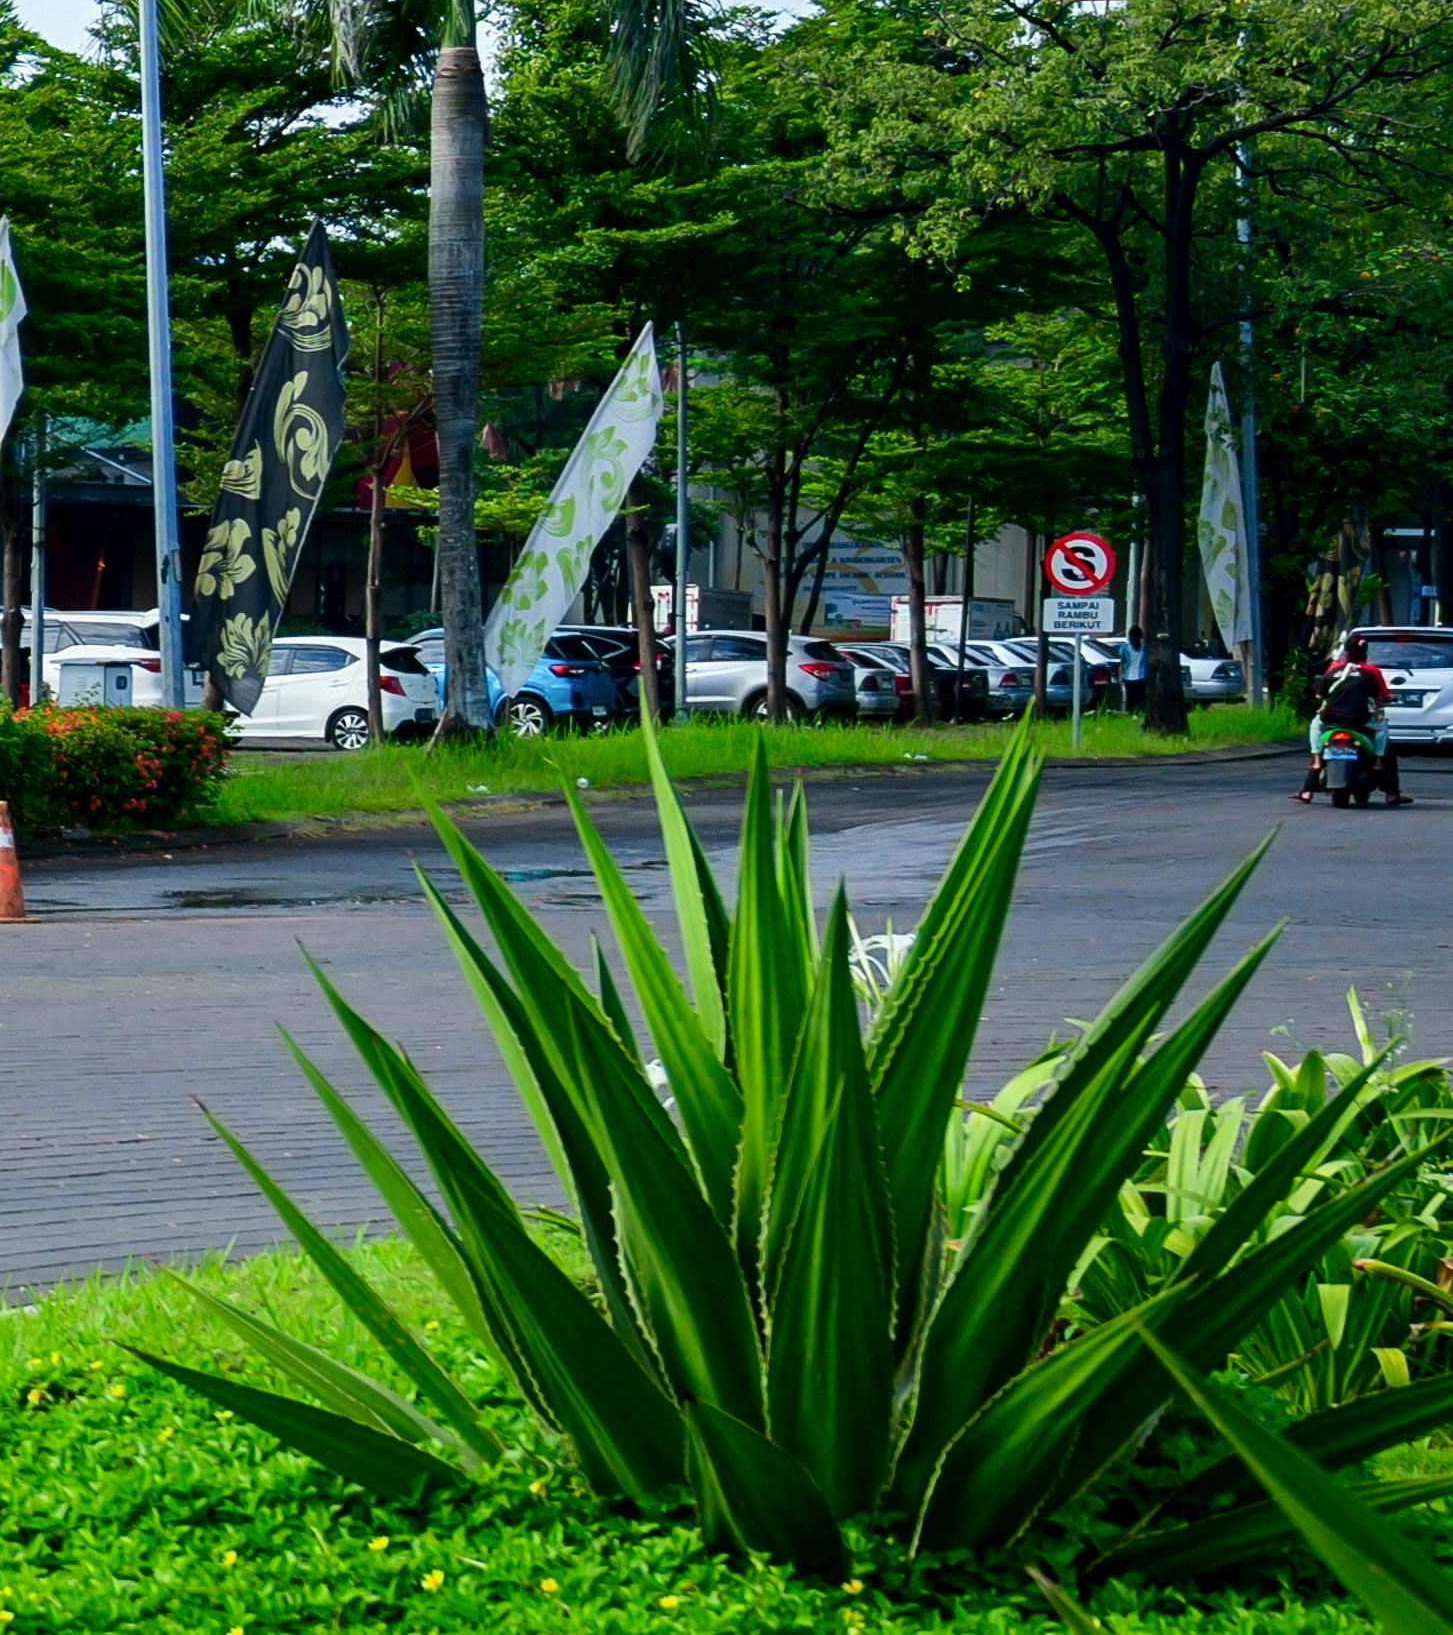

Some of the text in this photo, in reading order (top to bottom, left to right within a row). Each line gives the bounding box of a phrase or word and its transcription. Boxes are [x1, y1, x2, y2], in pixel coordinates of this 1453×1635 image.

[1057, 601, 1100, 610] SAMPAI
[1058, 611, 1098, 620] RAMBU
[1053, 620, 1102, 629] BERIKUT
